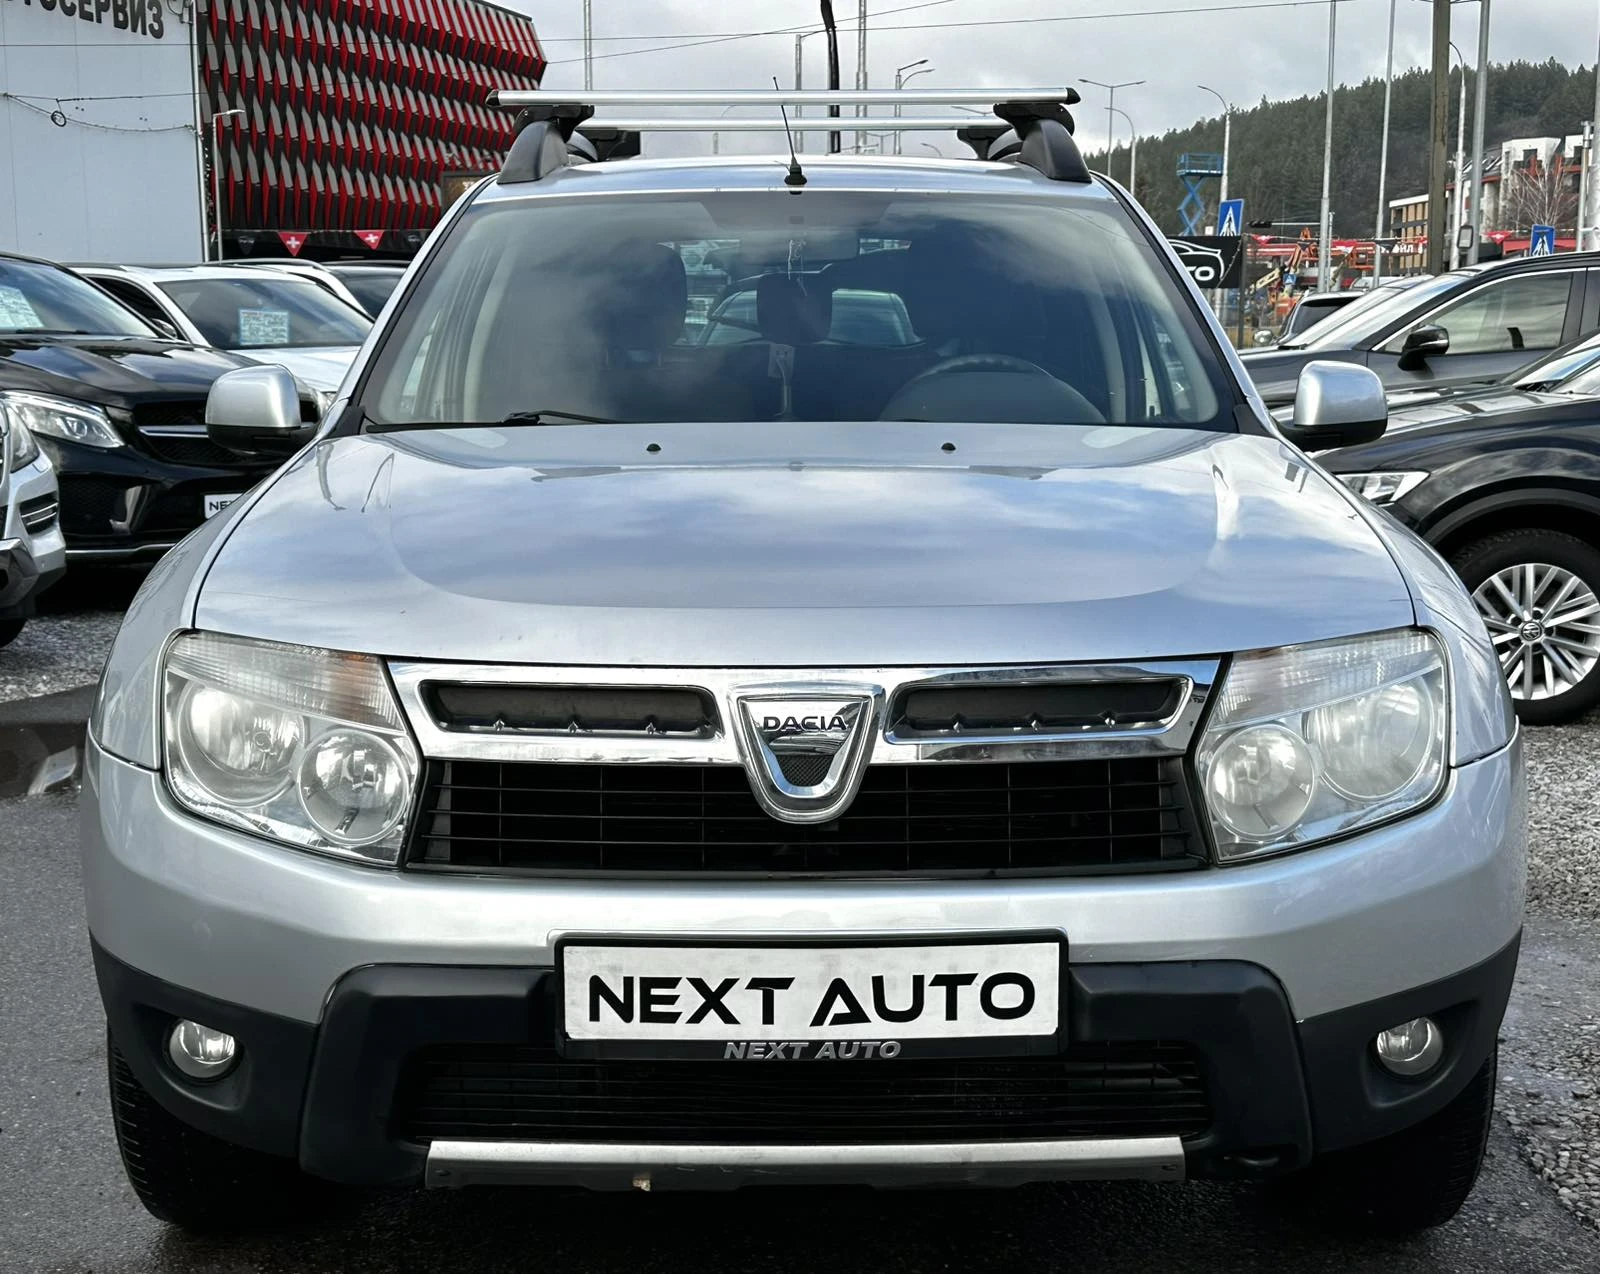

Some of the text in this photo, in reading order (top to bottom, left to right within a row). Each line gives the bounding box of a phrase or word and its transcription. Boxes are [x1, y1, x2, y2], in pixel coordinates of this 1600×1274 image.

[24, 0, 164, 39] ЕРВИЗ
[209, 500, 232, 511] NE
[763, 716, 847, 730] DACIA
[589, 972, 1036, 1027] NEXT AUTO
[723, 1040, 902, 1060] NEXT AUTO
